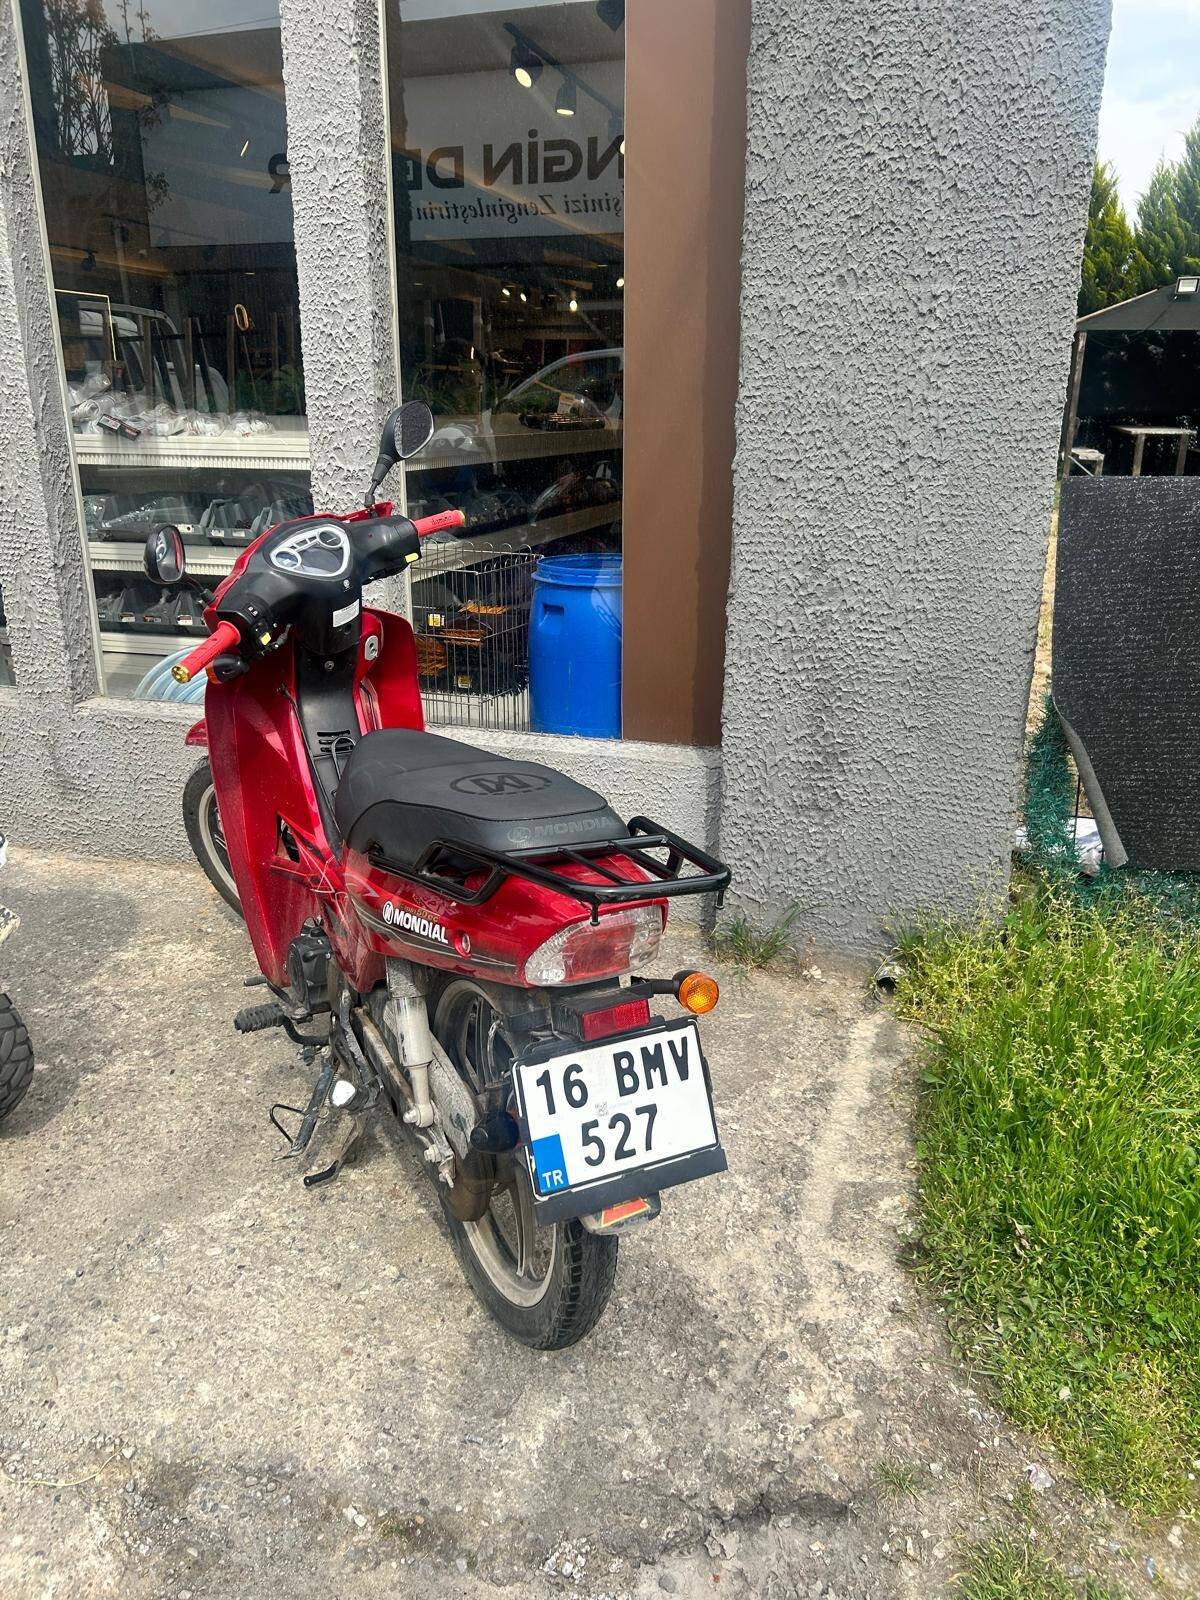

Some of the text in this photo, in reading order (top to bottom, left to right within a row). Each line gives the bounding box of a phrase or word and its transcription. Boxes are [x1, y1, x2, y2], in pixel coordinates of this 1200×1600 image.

[393, 908, 449, 944] MONDIAL
[536, 1036, 689, 1115] 16 BMV
[581, 1103, 658, 1167] 527
[542, 1170, 563, 1187] TR
